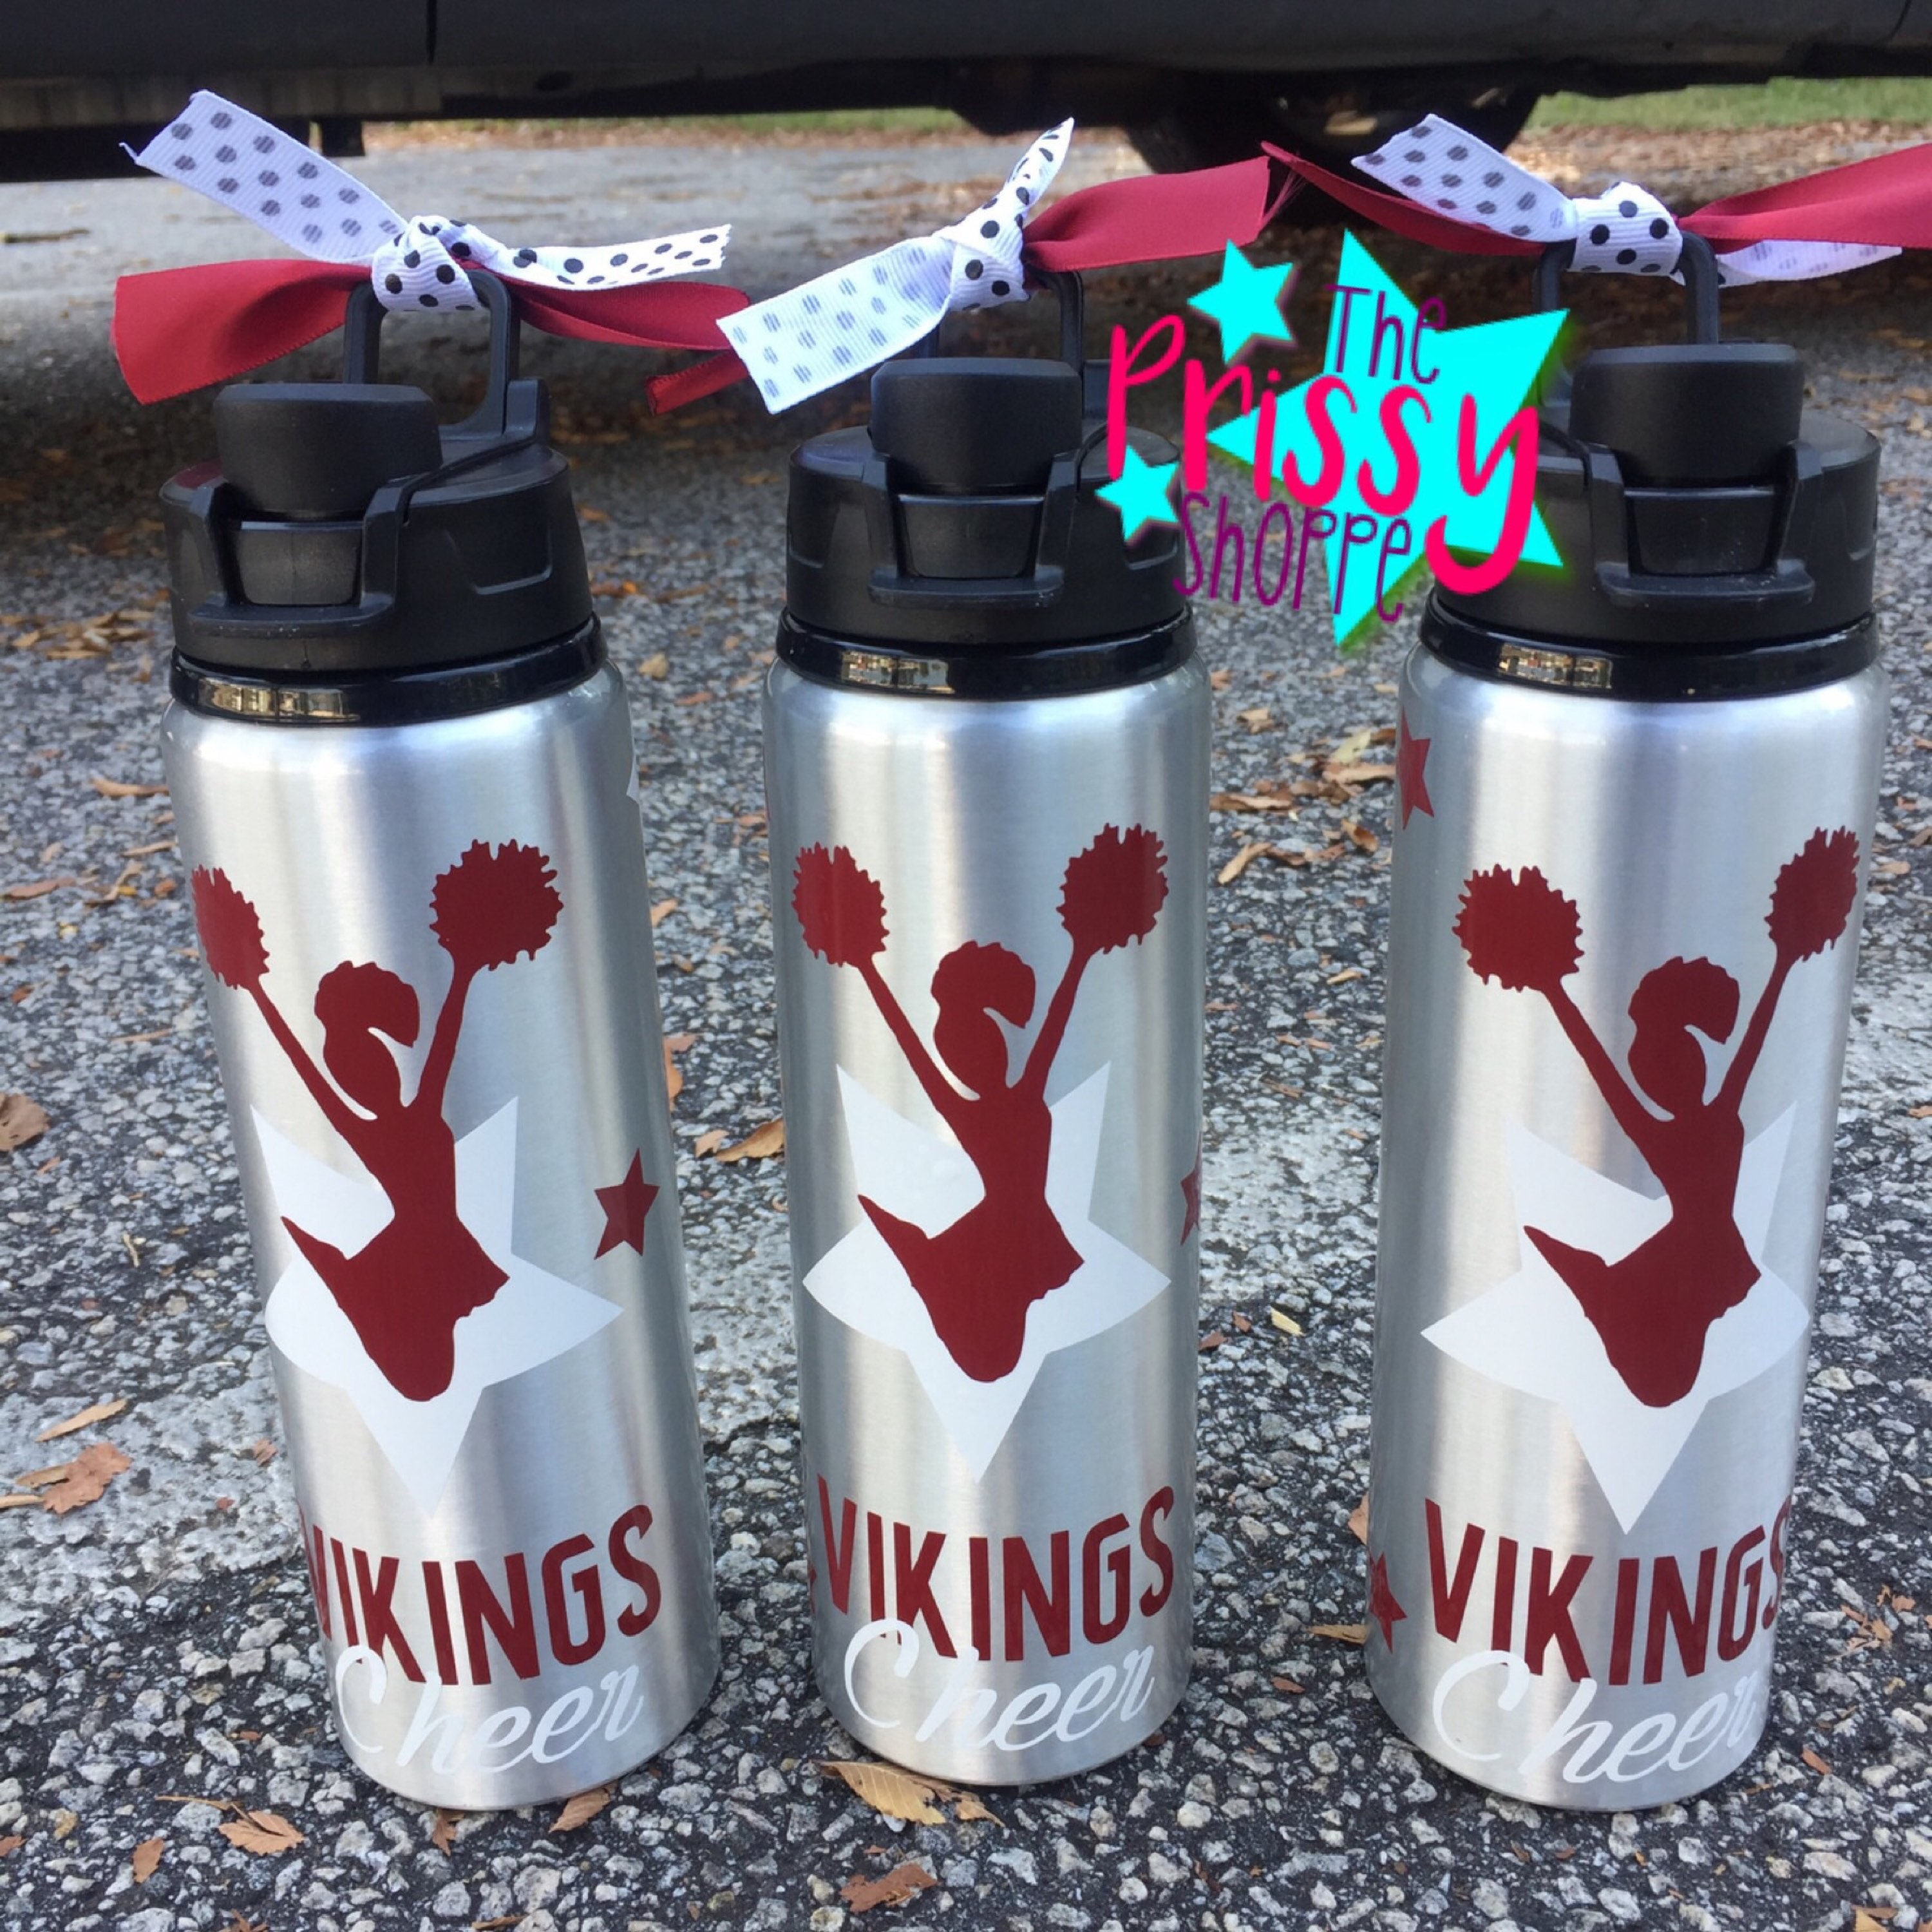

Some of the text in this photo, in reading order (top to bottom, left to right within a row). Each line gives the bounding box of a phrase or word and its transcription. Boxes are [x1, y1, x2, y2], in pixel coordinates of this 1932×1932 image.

[298, 1501, 662, 1685] VIKINGS
[817, 1473, 1175, 1662] VIKINGS
[336, 1644, 644, 1774] Cheer
[844, 1618, 1155, 1750] Cheer
[1433, 1651, 1757, 1783] Cheer
